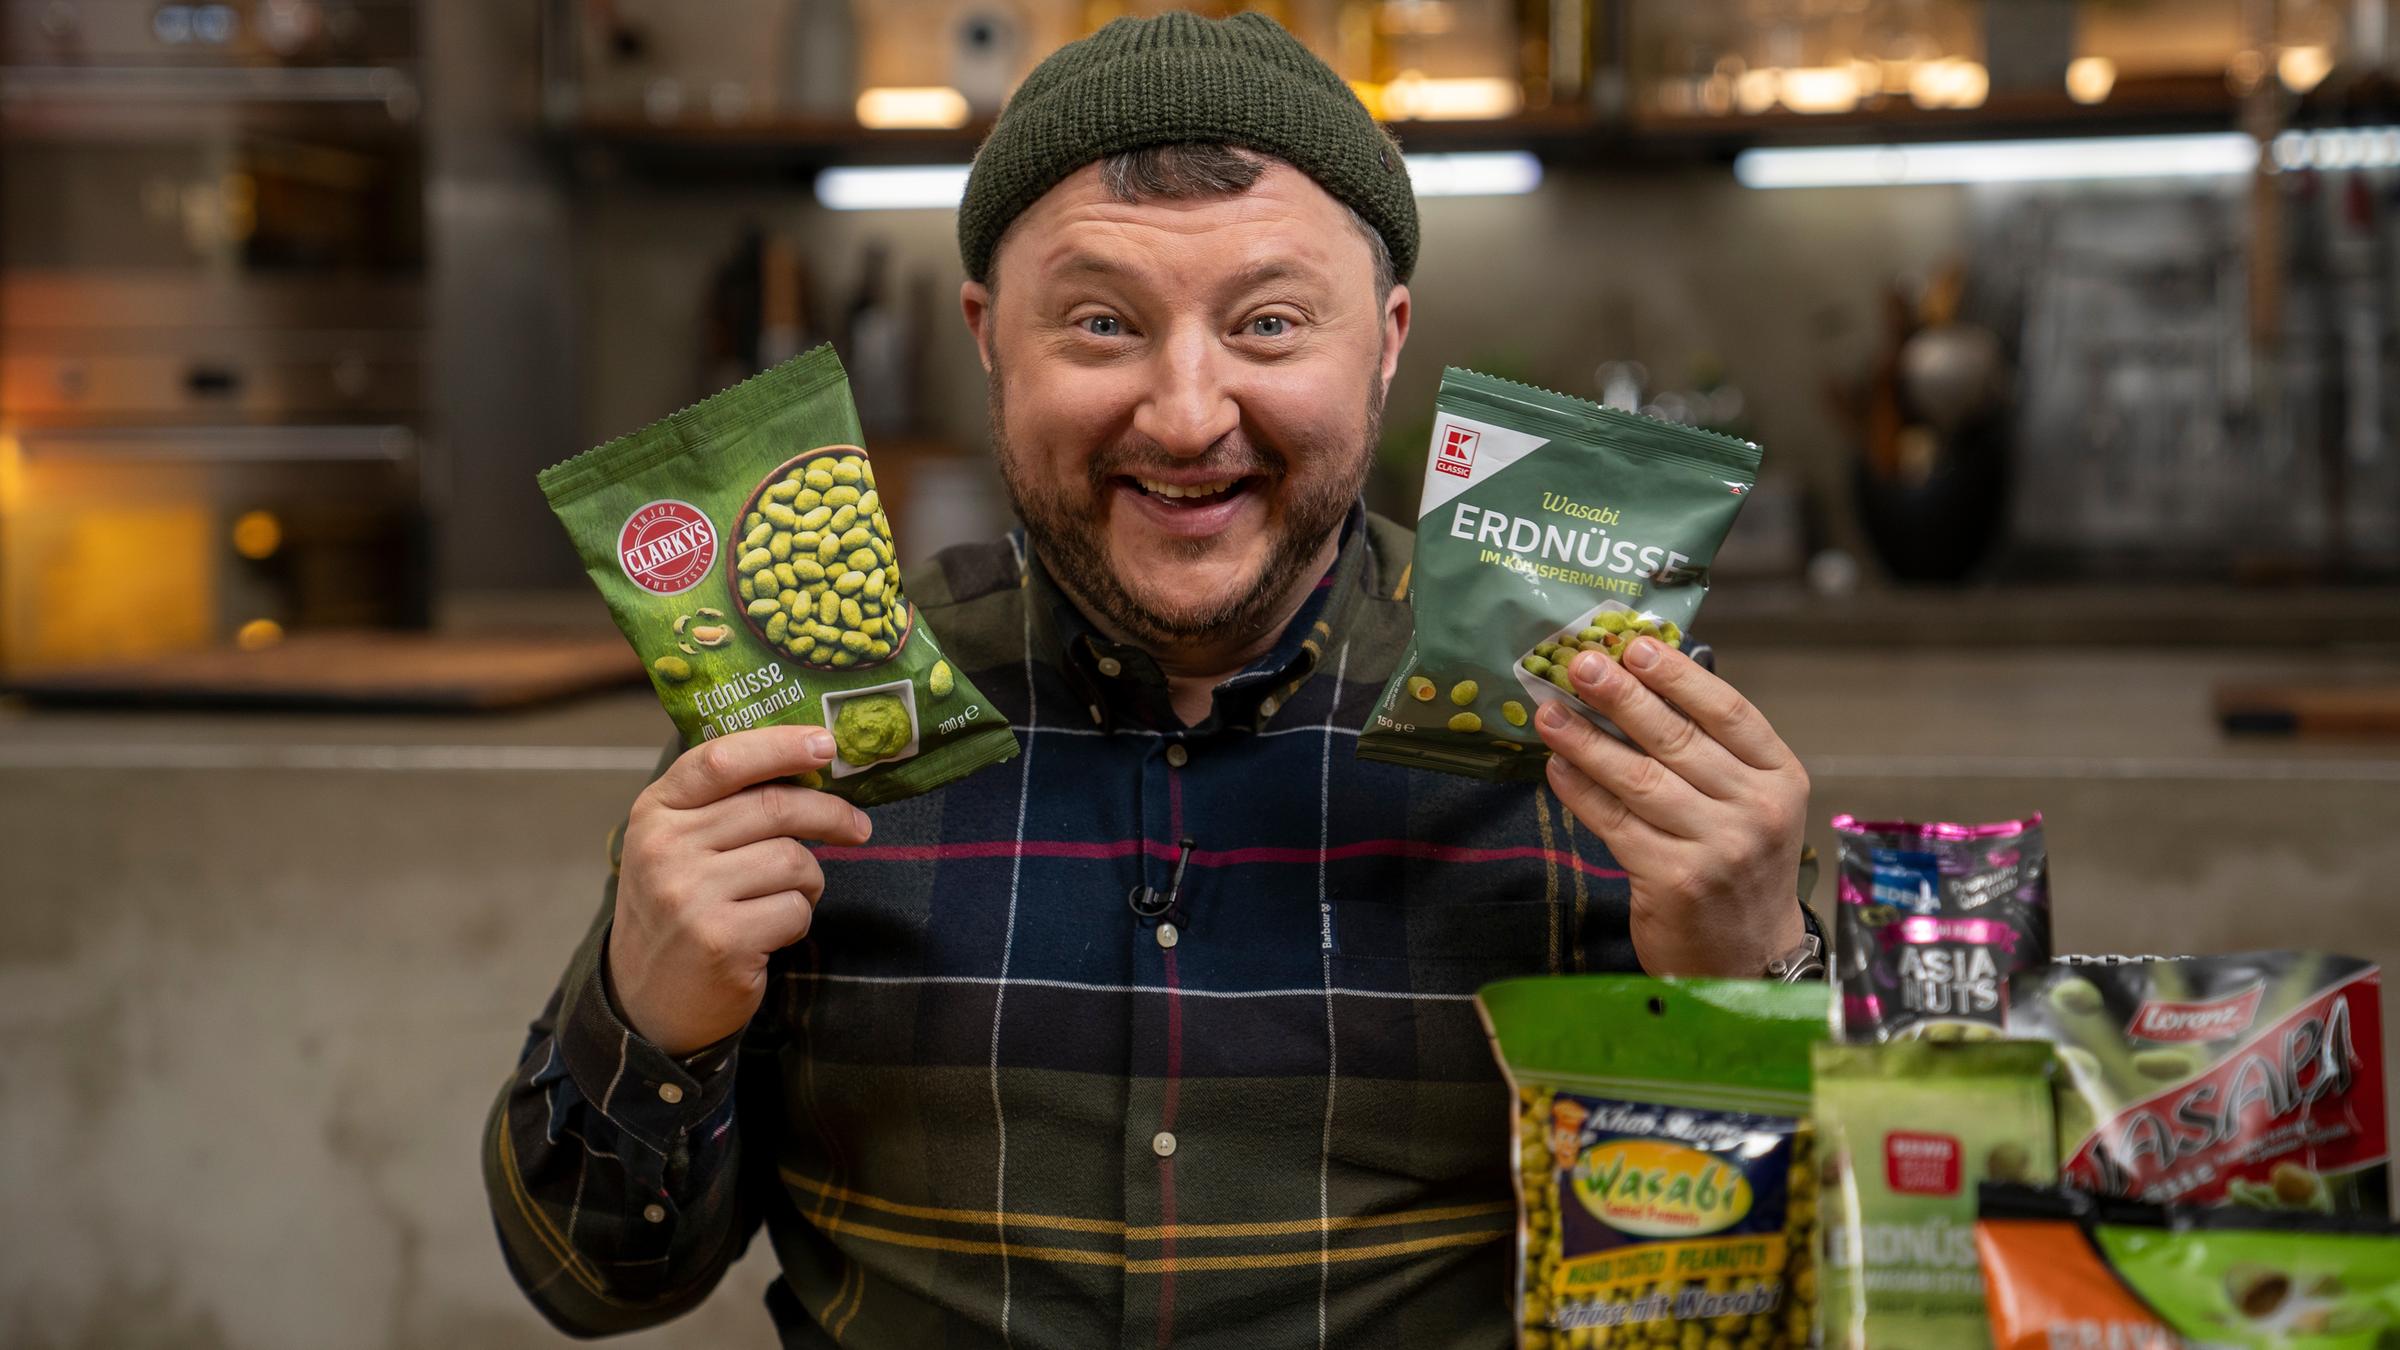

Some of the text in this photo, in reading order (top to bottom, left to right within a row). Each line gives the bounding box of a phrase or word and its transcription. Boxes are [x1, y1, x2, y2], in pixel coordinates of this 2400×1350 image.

[1437, 462, 1470, 477] CLASSIC
[632, 506, 676, 531] ENJOY
[1541, 491, 1621, 526] Wasabi
[626, 521, 710, 573] CLARKYS
[1450, 502, 1690, 583] ERDNÜSSE
[1479, 549, 1501, 568] IM
[645, 577, 668, 591] THE
[693, 662, 784, 718] Erdnüsse
[716, 679, 806, 735] Teigmantel
[1377, 715, 1393, 728] 150
[1874, 884, 1941, 911] EDEA
[1321, 912, 1332, 949] Barbour
[1899, 945, 1998, 984] ASIA
[1902, 978, 1999, 1015] NUTS
[2143, 1005, 2240, 1031] Lorenz
[1580, 1151, 1743, 1211] Wasabi
[1675, 1243, 1766, 1271] PEANUTS
[1674, 1284, 1783, 1321] Wasabi
